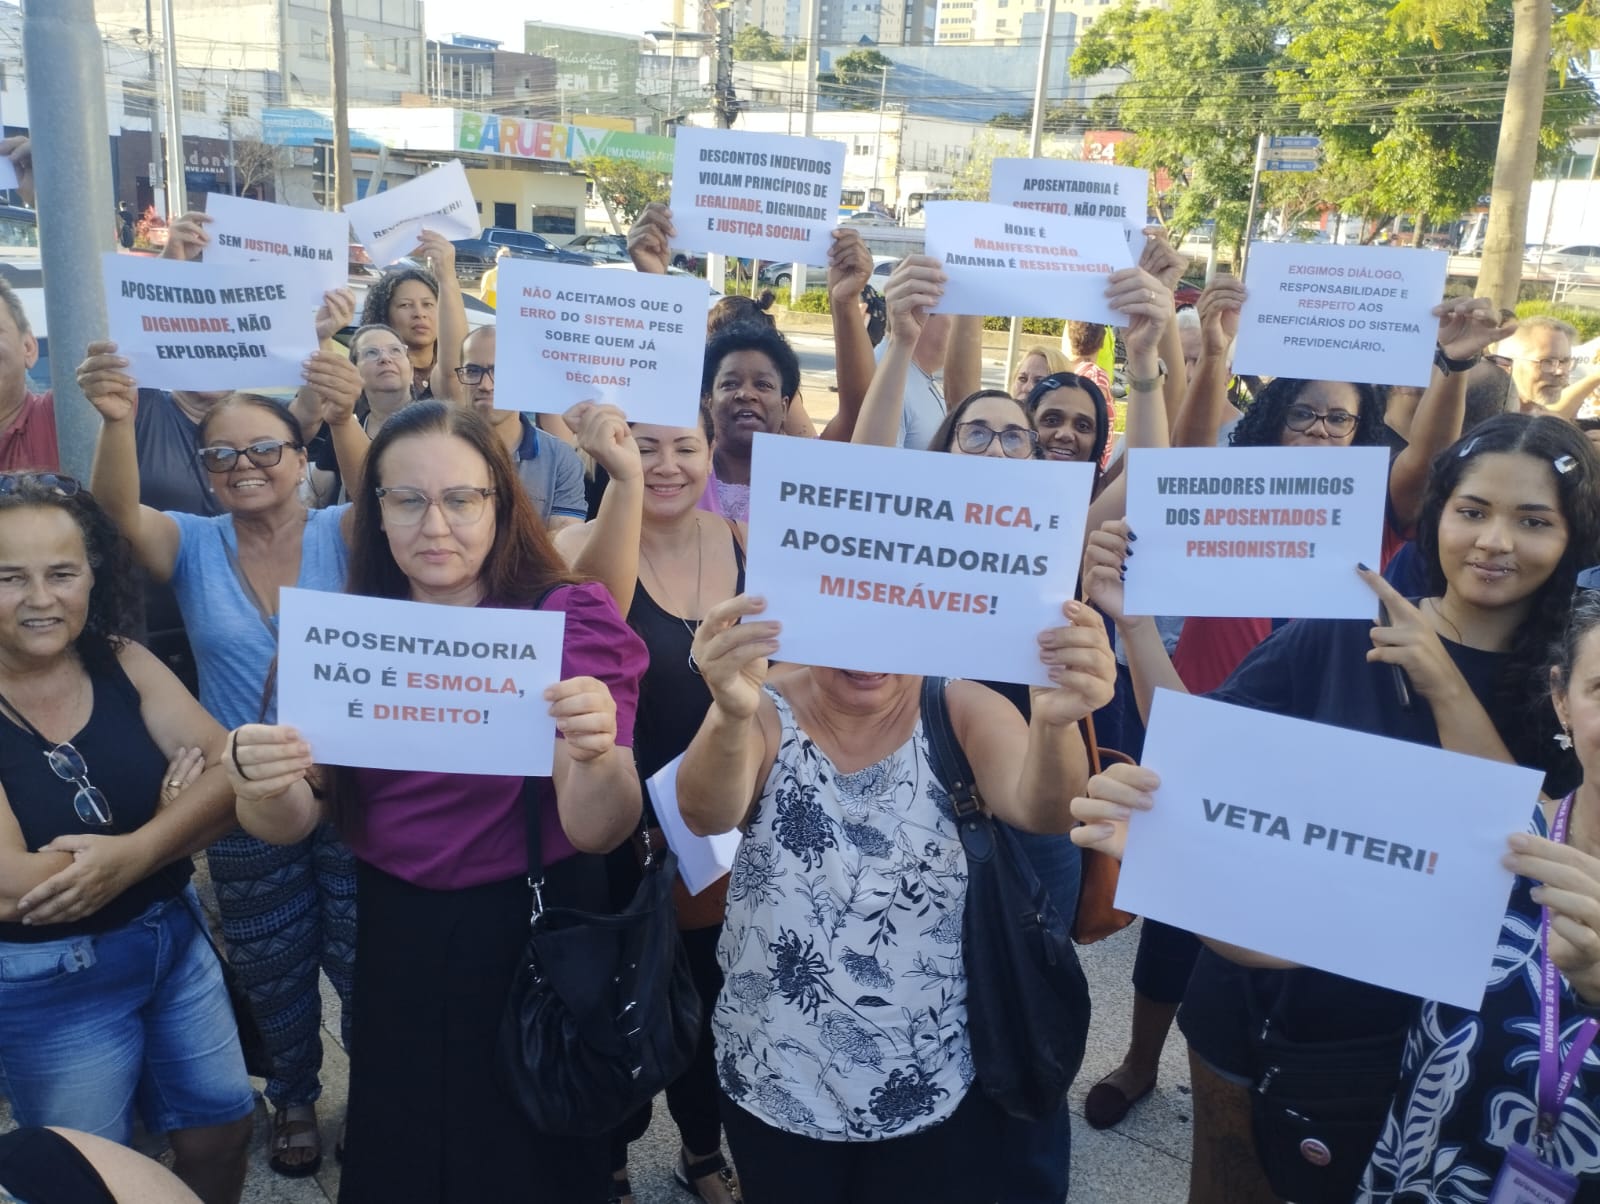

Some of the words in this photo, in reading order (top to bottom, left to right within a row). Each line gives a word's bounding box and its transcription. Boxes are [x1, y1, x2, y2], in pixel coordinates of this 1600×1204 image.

[459, 111, 574, 159] BARUERI
[700, 149, 767, 166] DESCONTOS
[770, 155, 831, 175] INDEVIDOS
[699, 172, 742, 187] VIOLAM
[745, 174, 807, 196] PRINCÍPIOS
[813, 184, 828, 198] DE
[1023, 178, 1111, 194] APOSENTADORIA
[1113, 180, 1119, 195] É
[695, 194, 763, 214] LEGALIDADE,
[766, 201, 827, 221] DIGNIDADE
[1074, 202, 1096, 216] NÃO
[1099, 204, 1126, 218] PODE
[708, 218, 714, 230] E
[716, 219, 763, 237] JUSTIÇA
[766, 224, 810, 241] SOCIAL!
[1005, 223, 1035, 237] HOJE
[1039, 225, 1046, 238] É
[219, 234, 241, 248] SEM
[294, 245, 315, 259] NÃO
[319, 247, 334, 261] HÁ
[1009, 257, 1016, 268] É
[1288, 265, 1344, 277] EXIGIMOS
[122, 280, 216, 304] APOSENTADO
[219, 283, 286, 304] MERECE
[523, 286, 551, 299] NÃO
[556, 291, 635, 308] ACEITAMOS
[641, 300, 668, 312] QUE
[673, 304, 682, 313] O
[1280, 282, 1397, 297] RESPONSABILIDADE
[1400, 289, 1408, 299] E
[1298, 299, 1356, 311] RESPEITO
[1358, 303, 1383, 312] AOS
[142, 316, 235, 333] DIGNIDADE,
[237, 314, 271, 332] NÃO
[520, 307, 556, 320] ERRO
[561, 312, 579, 322] DO
[584, 314, 644, 329] SISTEMA
[649, 321, 683, 333] PESE
[1258, 314, 1345, 328] BENEFICIÁRIOS
[1349, 320, 1366, 329] DO
[1369, 321, 1420, 333] SISTEMA
[545, 330, 590, 343] SOBRE
[595, 336, 634, 348] QUEM
[639, 339, 655, 351] JÁ
[1283, 336, 1385, 352] PREVIDENCIÁRIO.
[156, 342, 267, 361] EXPLORAÇÃO!
[541, 349, 625, 366] CONTRIBUIU
[630, 359, 657, 370] POR
[565, 370, 630, 387] DÉCADAS!
[1157, 477, 1265, 495] VEREADORES
[1270, 477, 1354, 495] INIMIGOS
[780, 481, 954, 521] PREFEITURA
[965, 503, 1040, 531] RICA,
[1049, 515, 1059, 529] E
[1166, 508, 1200, 525] DOS
[1204, 508, 1327, 526] APOSENTADOS
[1332, 509, 1341, 525] E
[781, 529, 1048, 576] APOSENTADORIAS
[1187, 540, 1315, 558] PENSIONISTAS!
[820, 575, 998, 615] MISERÁVEIS!
[305, 627, 536, 660] APOSENTADORIA
[314, 663, 371, 684] NÃO
[381, 667, 397, 688] É
[407, 672, 524, 698] ESMOLA,
[348, 699, 363, 718] É
[374, 704, 489, 724] DIREITO!
[1203, 799, 1290, 840] VETA
[1304, 823, 1438, 874] PITERI!
[1544, 988, 1554, 1004] DE
[1544, 1005, 1554, 1053] BARUERI
